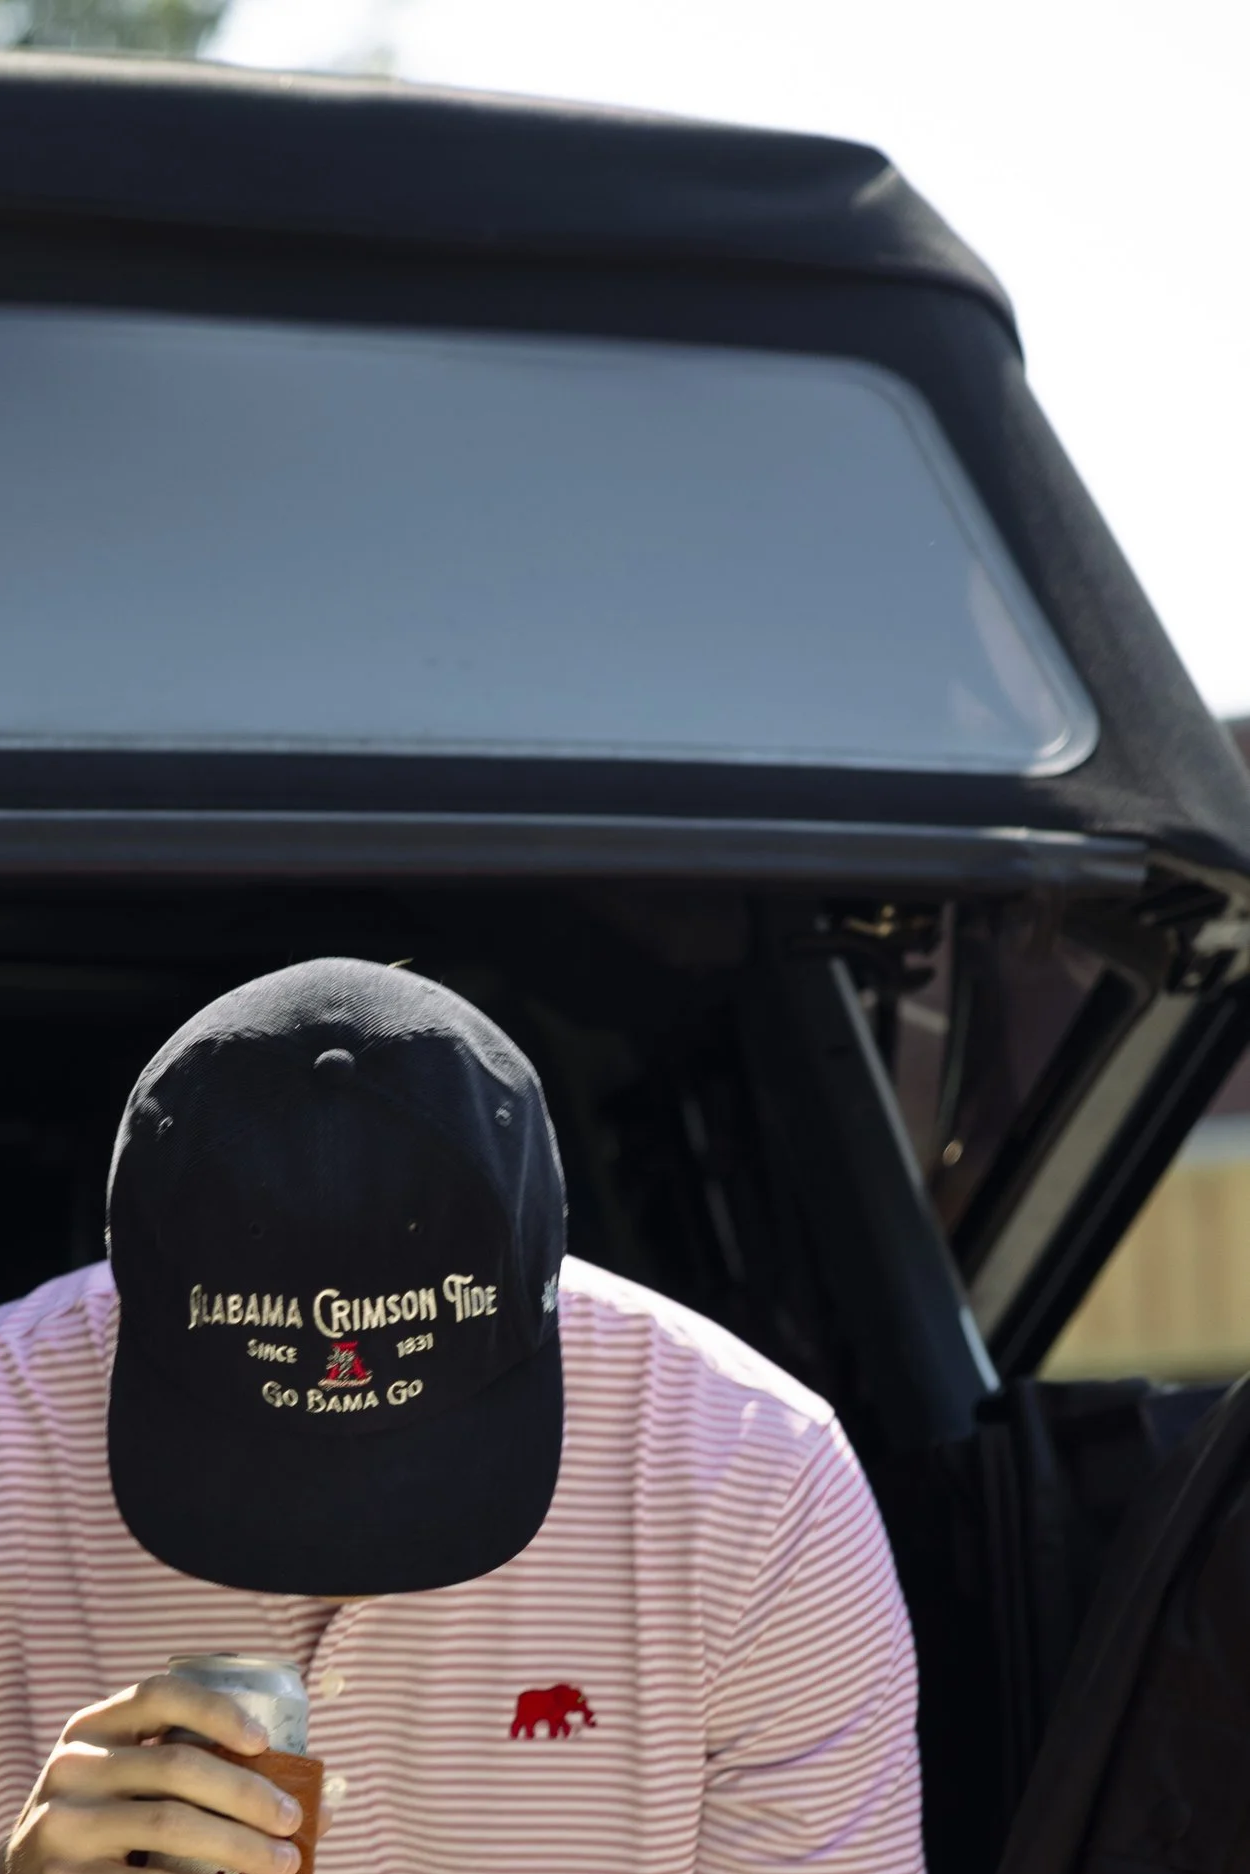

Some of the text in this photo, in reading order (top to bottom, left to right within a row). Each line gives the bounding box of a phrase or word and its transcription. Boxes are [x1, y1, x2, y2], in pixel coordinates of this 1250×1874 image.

[188, 1273, 498, 1339] ALABAMA CRIMSON TIDE
[247, 1338, 298, 1364] SINCE
